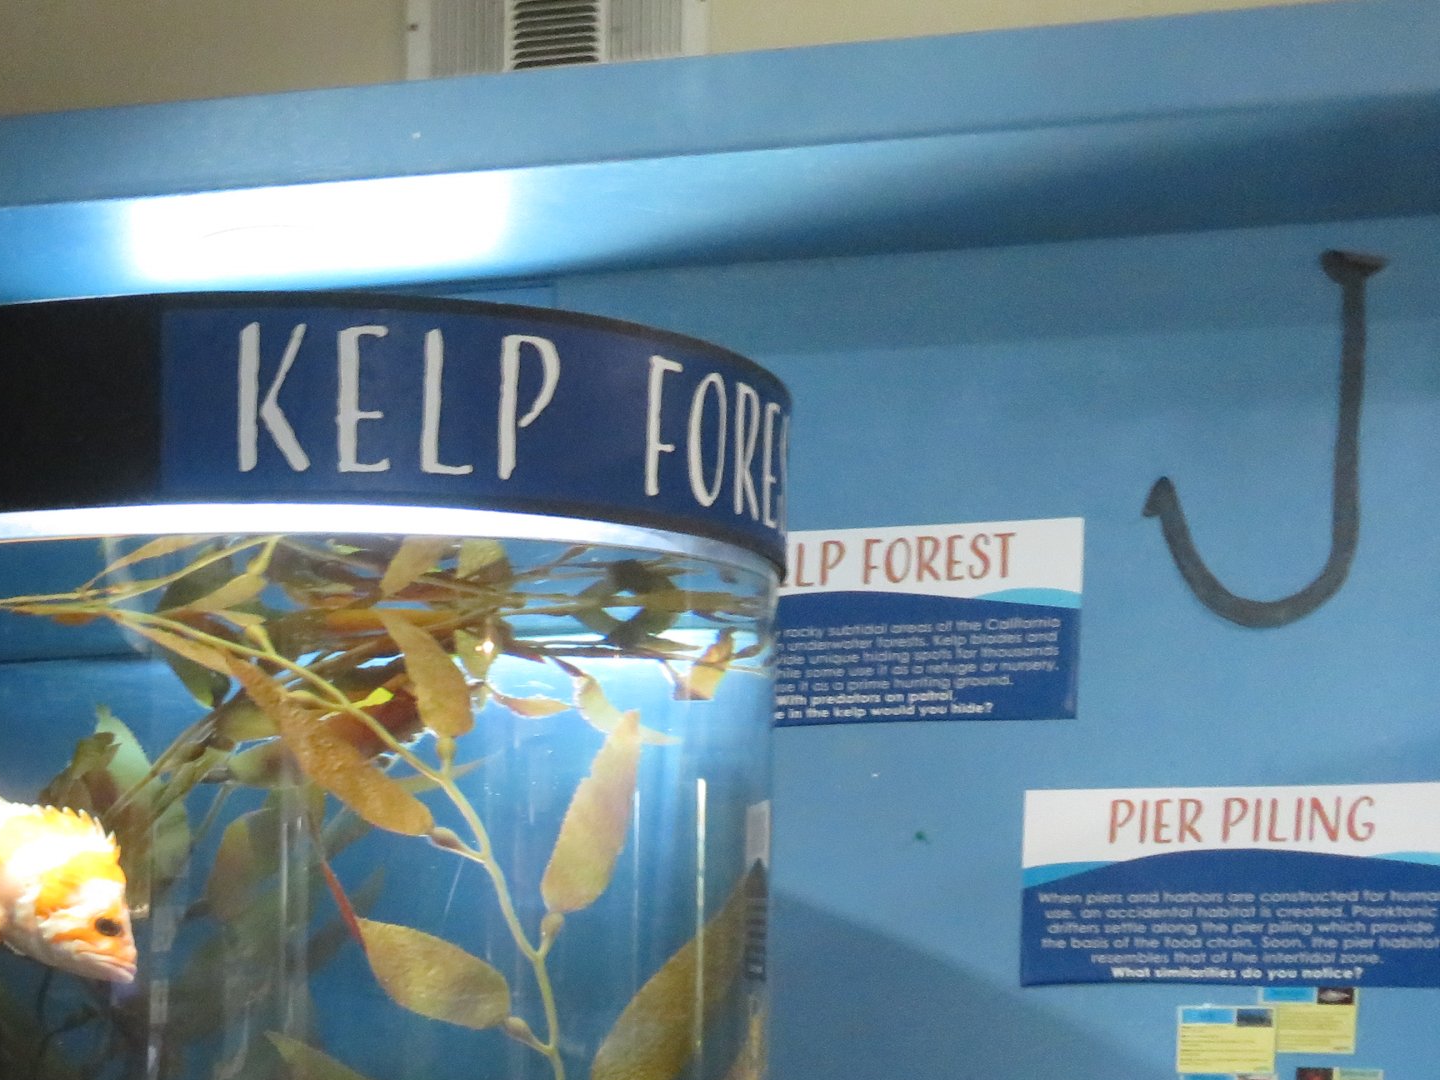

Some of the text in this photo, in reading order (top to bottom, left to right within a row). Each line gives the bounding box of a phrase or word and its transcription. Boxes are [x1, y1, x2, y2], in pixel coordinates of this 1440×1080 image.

[237, 321, 560, 480] KELP
[781, 532, 1016, 588] LP FOREST
[1109, 797, 1375, 843] PIER PILING
